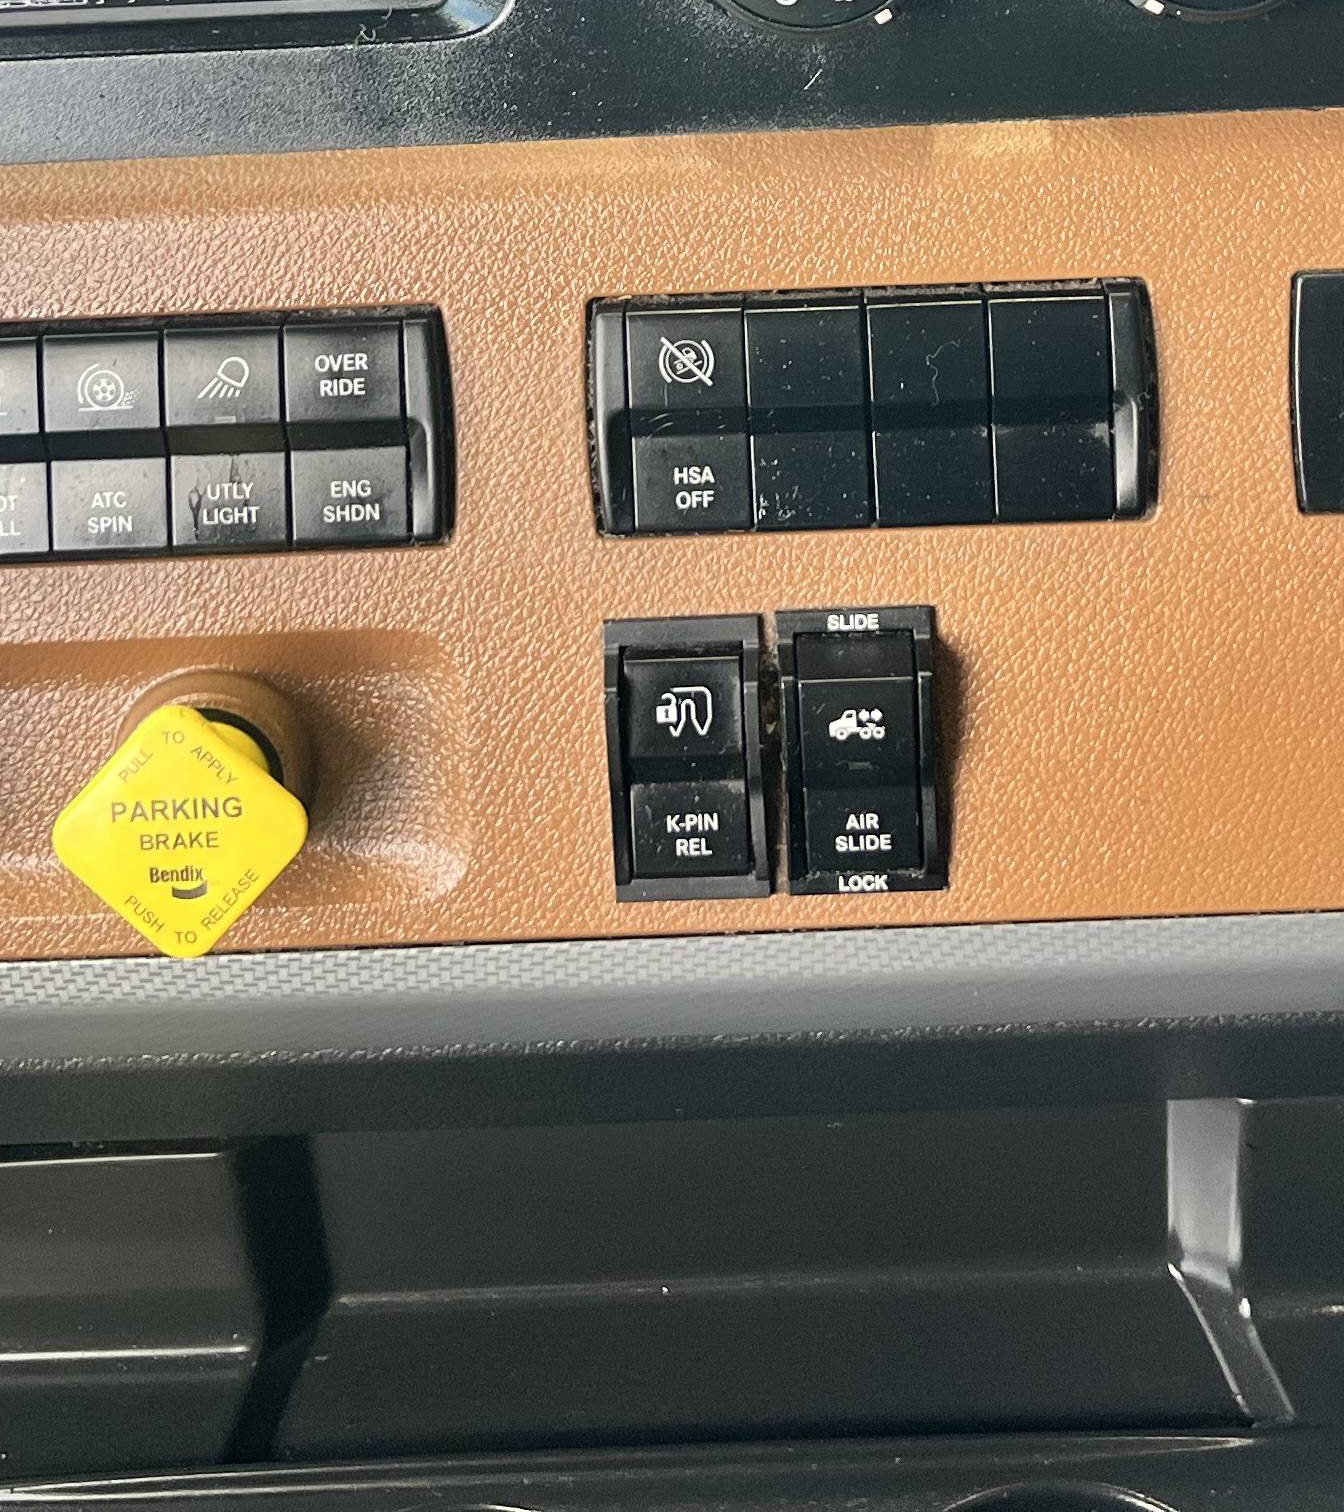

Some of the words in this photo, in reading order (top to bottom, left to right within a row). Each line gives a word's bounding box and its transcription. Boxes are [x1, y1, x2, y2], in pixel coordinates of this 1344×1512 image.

[314, 353, 369, 374] OVER
[319, 377, 366, 397] RIDE
[673, 465, 715, 485] HSA
[206, 481, 254, 502] UTLY
[330, 478, 372, 499] ENG
[90, 491, 127, 510] ATC
[675, 490, 715, 509] OFF
[202, 505, 260, 526] LIGHT
[323, 503, 380, 524] SHDN
[87, 515, 133, 535] SPIN
[827, 613, 880, 631] SLIDE
[118, 749, 154, 784] PULL
[161, 730, 185, 745] TO
[190, 745, 238, 786] APPLY
[111, 796, 244, 823] PARKING
[666, 812, 719, 833] K-PIN
[846, 812, 879, 830] AIR
[139, 831, 220, 852] BRAKE
[675, 838, 713, 857] REL
[835, 834, 893, 852] SLIDE
[149, 866, 204, 884] Bendix
[838, 874, 889, 892] LOCK
[124, 895, 166, 934] PUSH
[174, 930, 198, 945] TO
[200, 868, 260, 930] RELEASE
